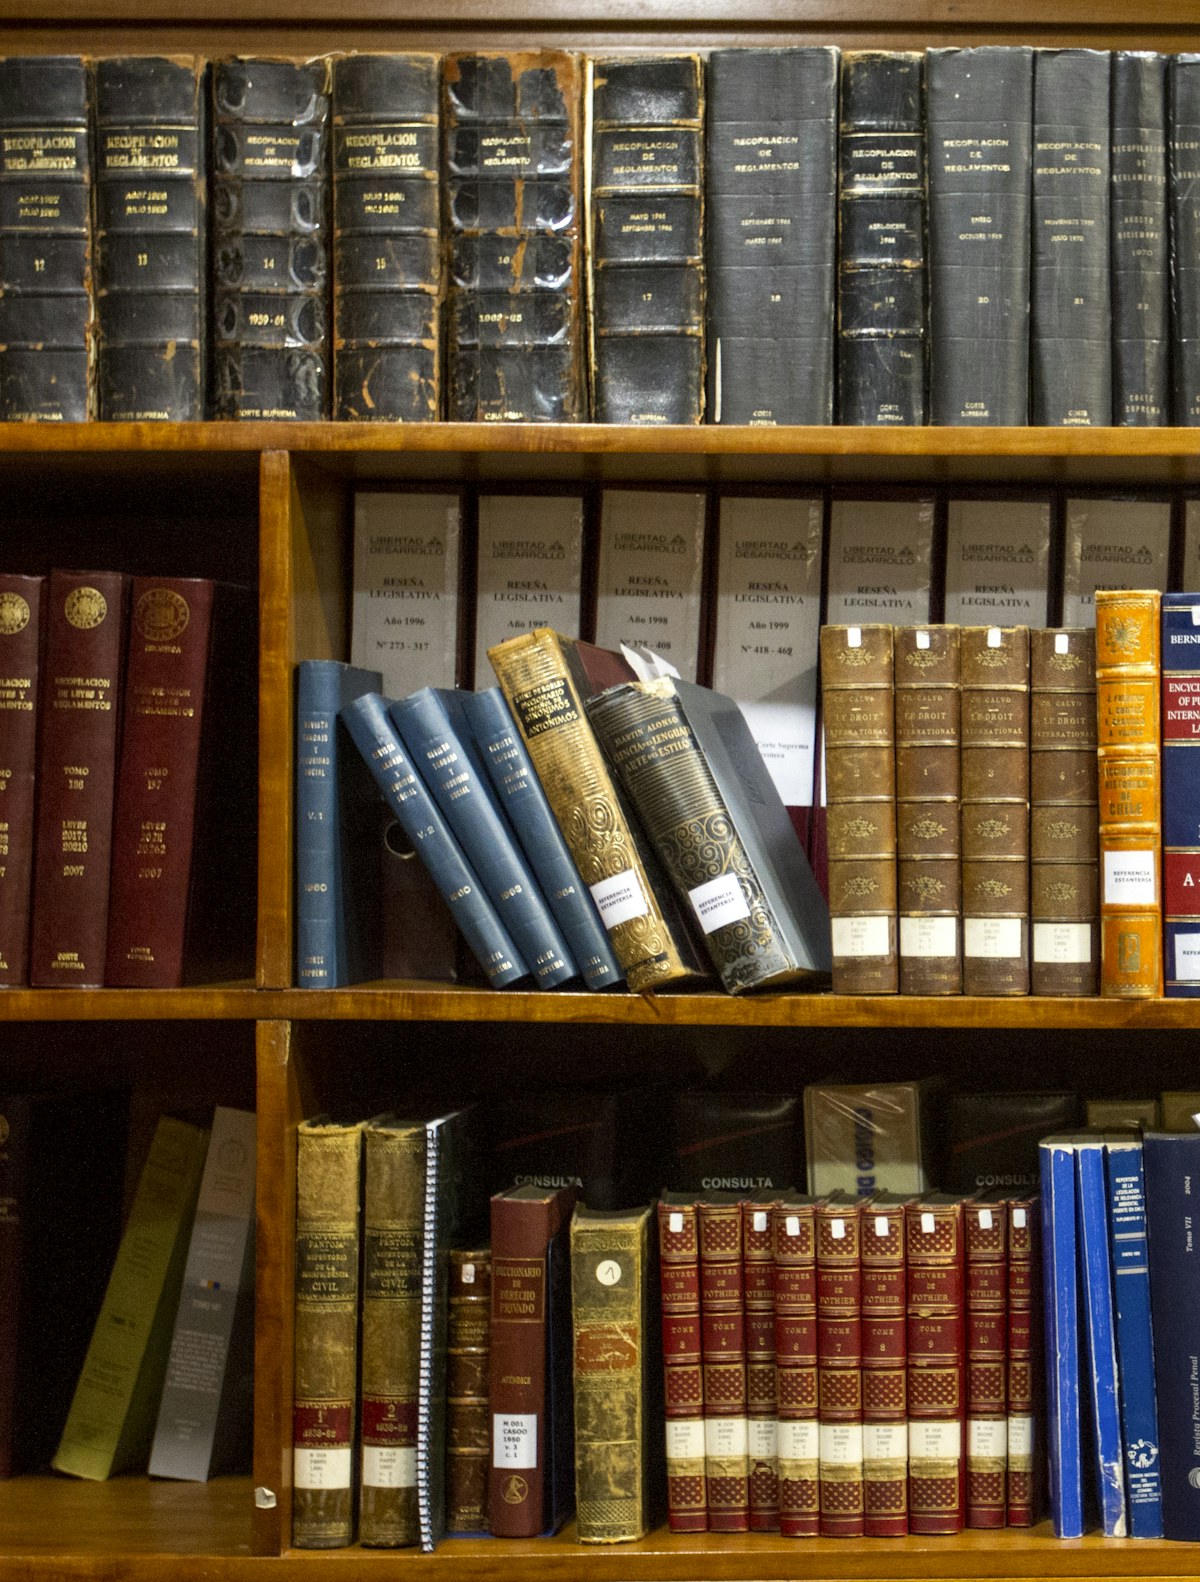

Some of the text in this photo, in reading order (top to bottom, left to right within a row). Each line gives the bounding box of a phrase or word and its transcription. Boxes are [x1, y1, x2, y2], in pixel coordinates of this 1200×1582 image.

[263, 258, 275, 269] 14
[375, 257, 387, 270] 15
[370, 537, 424, 546] LIBERTAD
[370, 547, 444, 556] DESARROLLO
[384, 577, 425, 588] RESEÑA
[370, 590, 440, 600] LEGISLATIVA
[384, 617, 425, 625] Año 1996
[628, 616, 646, 624] Año
[748, 621, 767, 629] Año
[1178, 696, 1191, 707] OF
[702, 1178, 773, 1189] CONSULTA
[1190, 1356, 1199, 1383] Penal
[1191, 1383, 1200, 1421] Procesal
